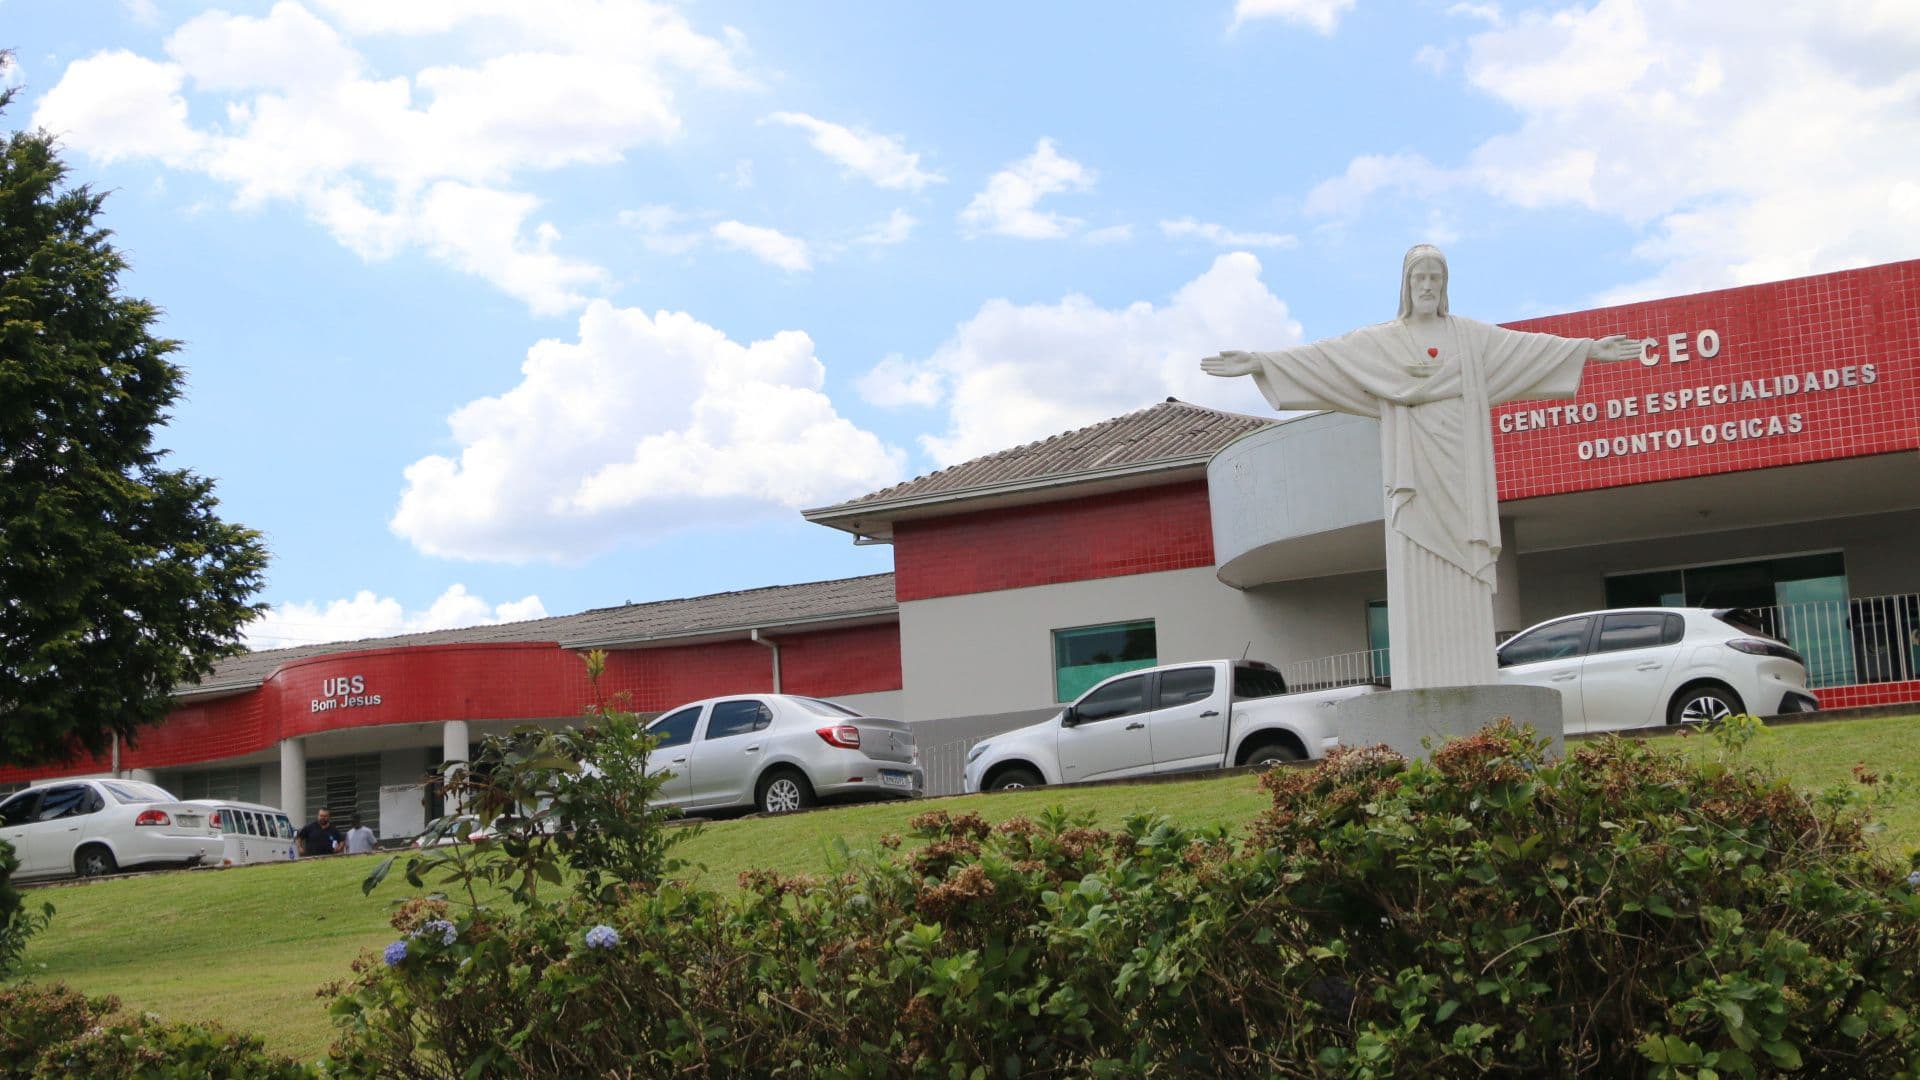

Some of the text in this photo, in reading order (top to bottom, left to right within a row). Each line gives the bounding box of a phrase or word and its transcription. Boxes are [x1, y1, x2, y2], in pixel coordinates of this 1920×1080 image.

[1640, 328, 1720, 366] CEO
[1499, 363, 1877, 433] CENTRO DE ESPECIALIDADES
[1577, 412, 1803, 460] ODONTOLOGICAS
[311, 694, 382, 713] Bom Jesus
[323, 675, 365, 698] UBS
